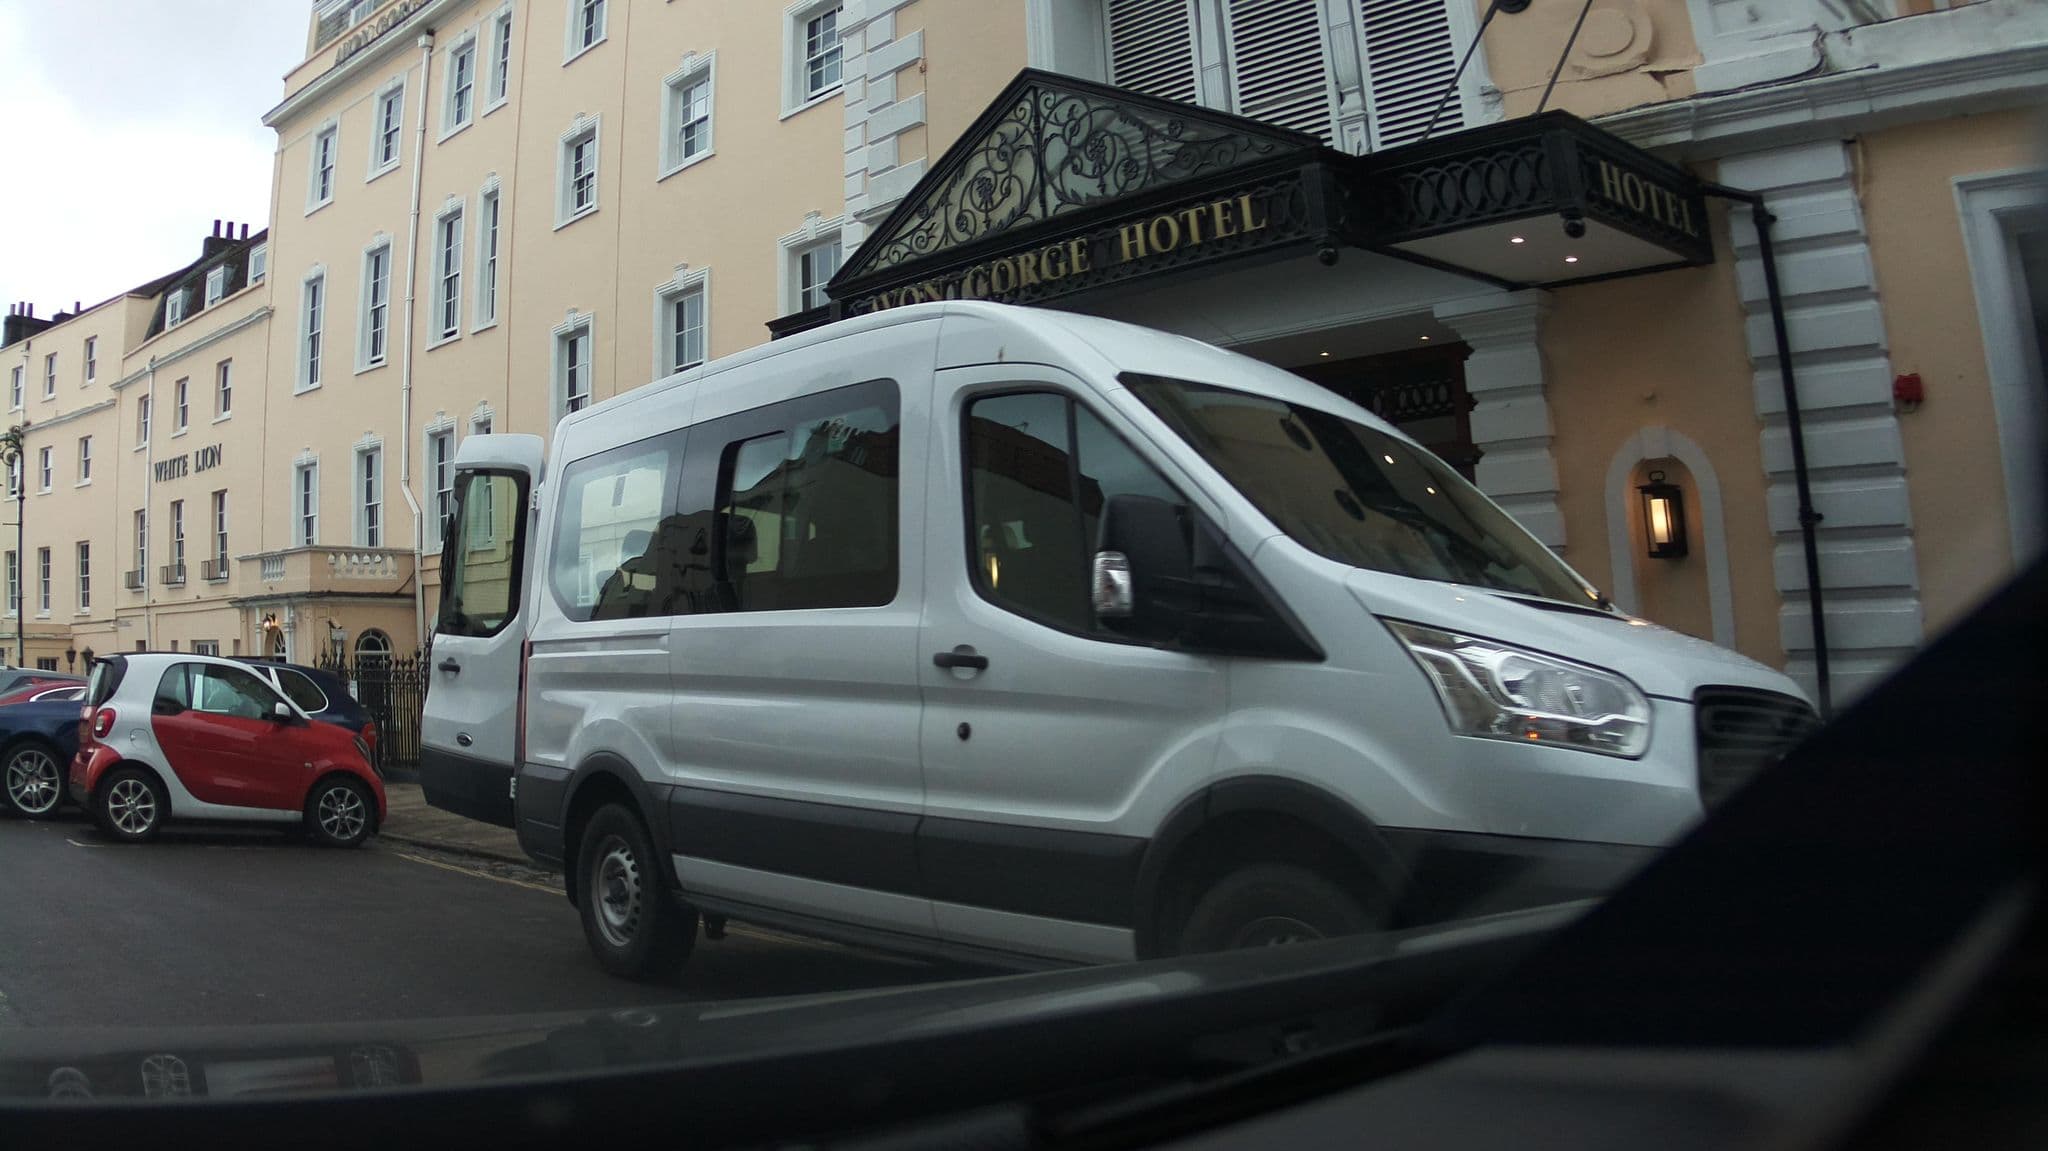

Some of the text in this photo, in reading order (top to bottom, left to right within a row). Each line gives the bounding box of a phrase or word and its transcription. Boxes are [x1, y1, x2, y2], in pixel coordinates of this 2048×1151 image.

[1600, 160, 1700, 237] HOTEL
[960, 237, 1090, 297] GORGE
[1119, 193, 1266, 262] HOTEL
[154, 443, 222, 483] WHITE LION
